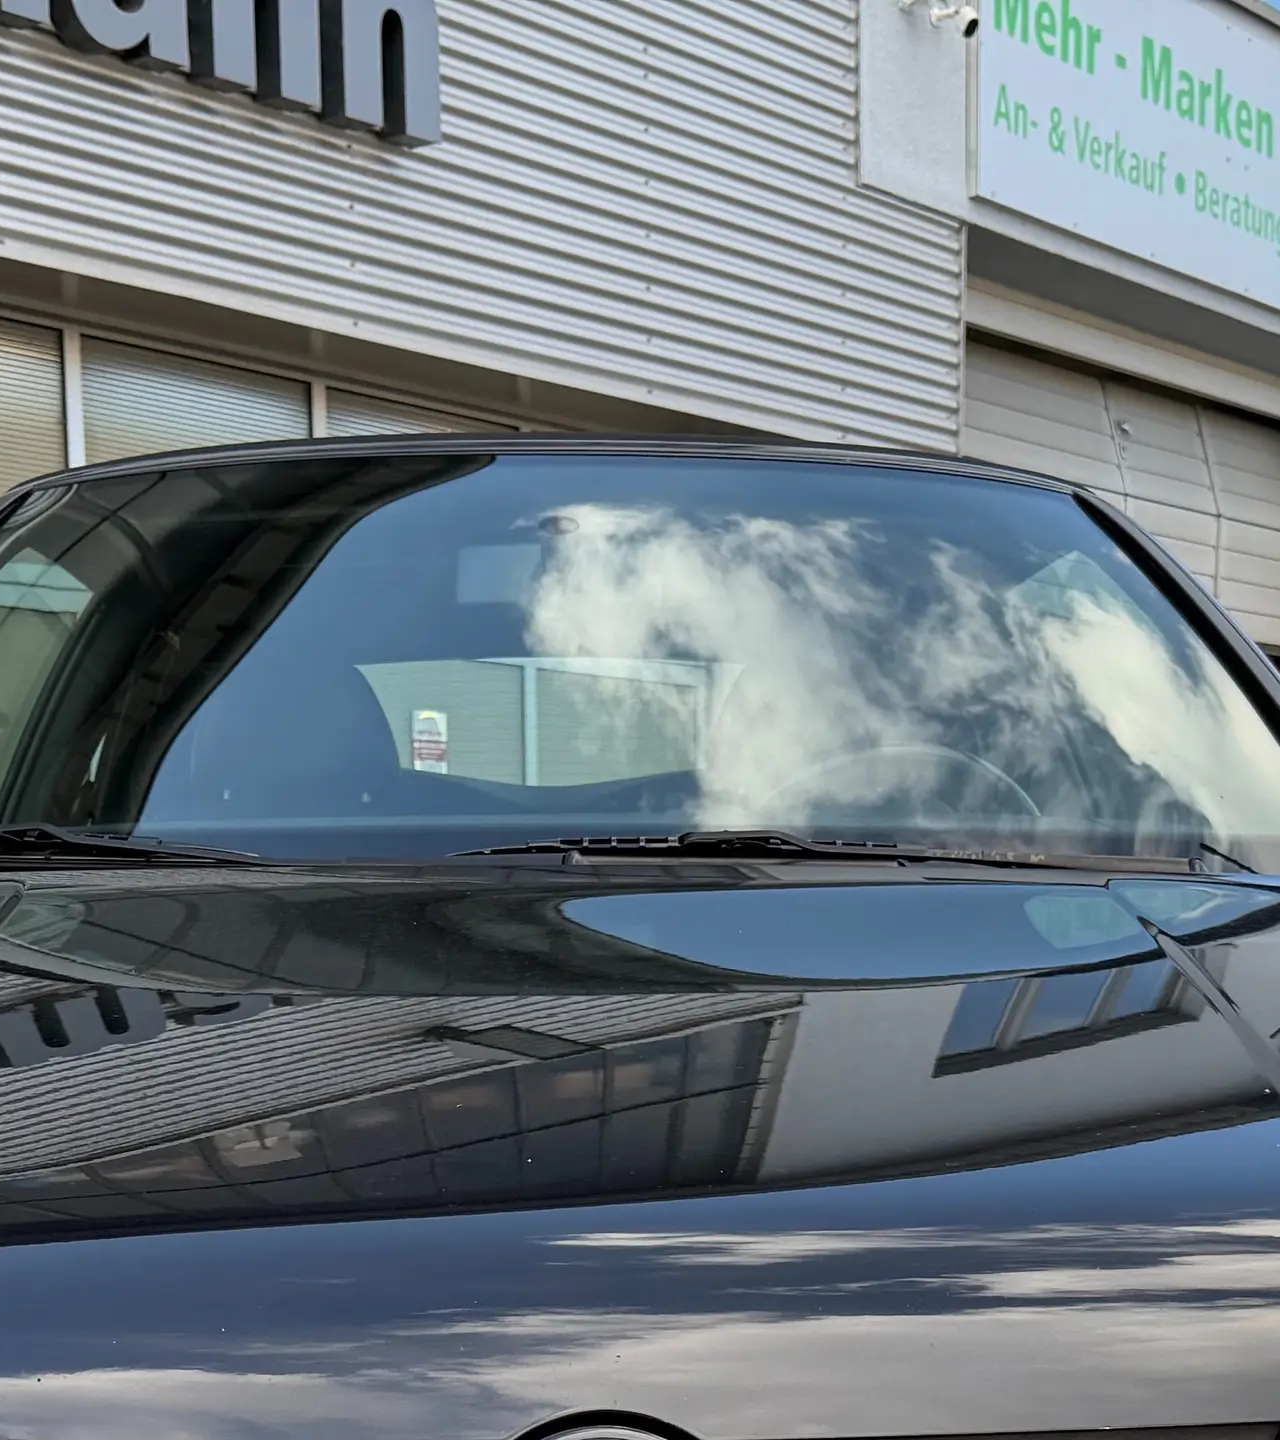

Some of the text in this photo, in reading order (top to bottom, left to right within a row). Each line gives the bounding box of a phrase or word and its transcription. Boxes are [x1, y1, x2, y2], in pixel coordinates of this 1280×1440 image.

[993, 0, 1101, 76] Mehr
[1141, 35, 1273, 158] Marken
[993, 83, 1039, 140] An-
[1048, 106, 1066, 156] &
[1073, 115, 1167, 196] Verkauf
